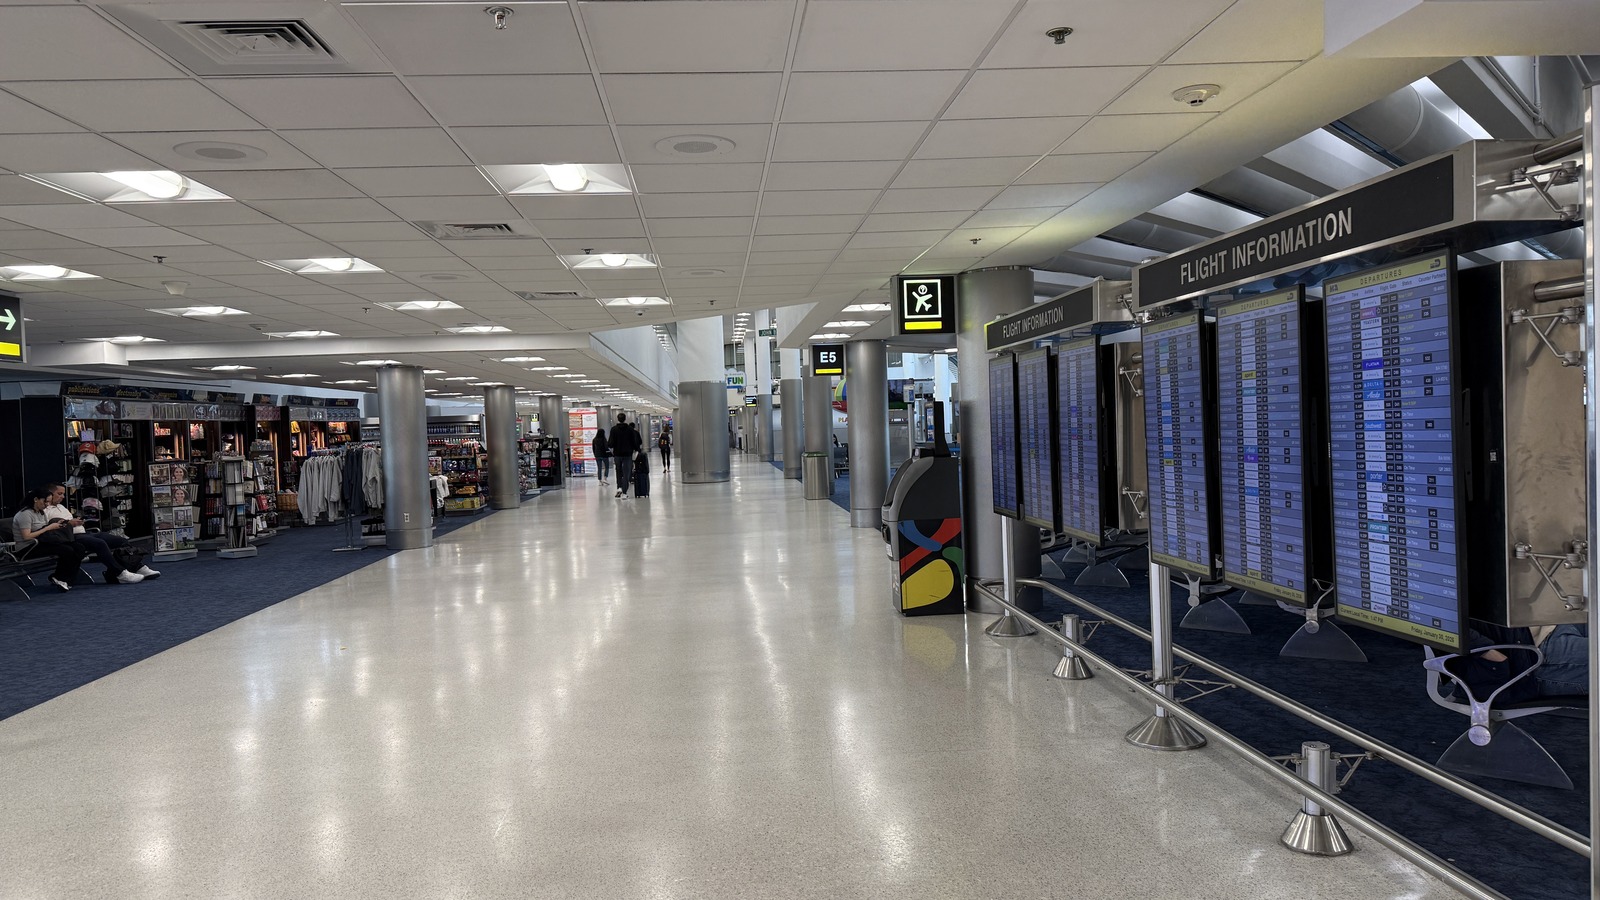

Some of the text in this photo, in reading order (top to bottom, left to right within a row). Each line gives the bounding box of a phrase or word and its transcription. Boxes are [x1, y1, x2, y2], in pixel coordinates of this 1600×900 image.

[1180, 206, 1352, 285] FLIGHT INFORMATION
[1360, 269, 1402, 285] DEPARTURES
[1002, 306, 1064, 338] FLIGHT INFORMATION
[820, 352, 837, 363] E5
[68, 385, 99, 395] publications
[1424, 630, 1438, 639] January
